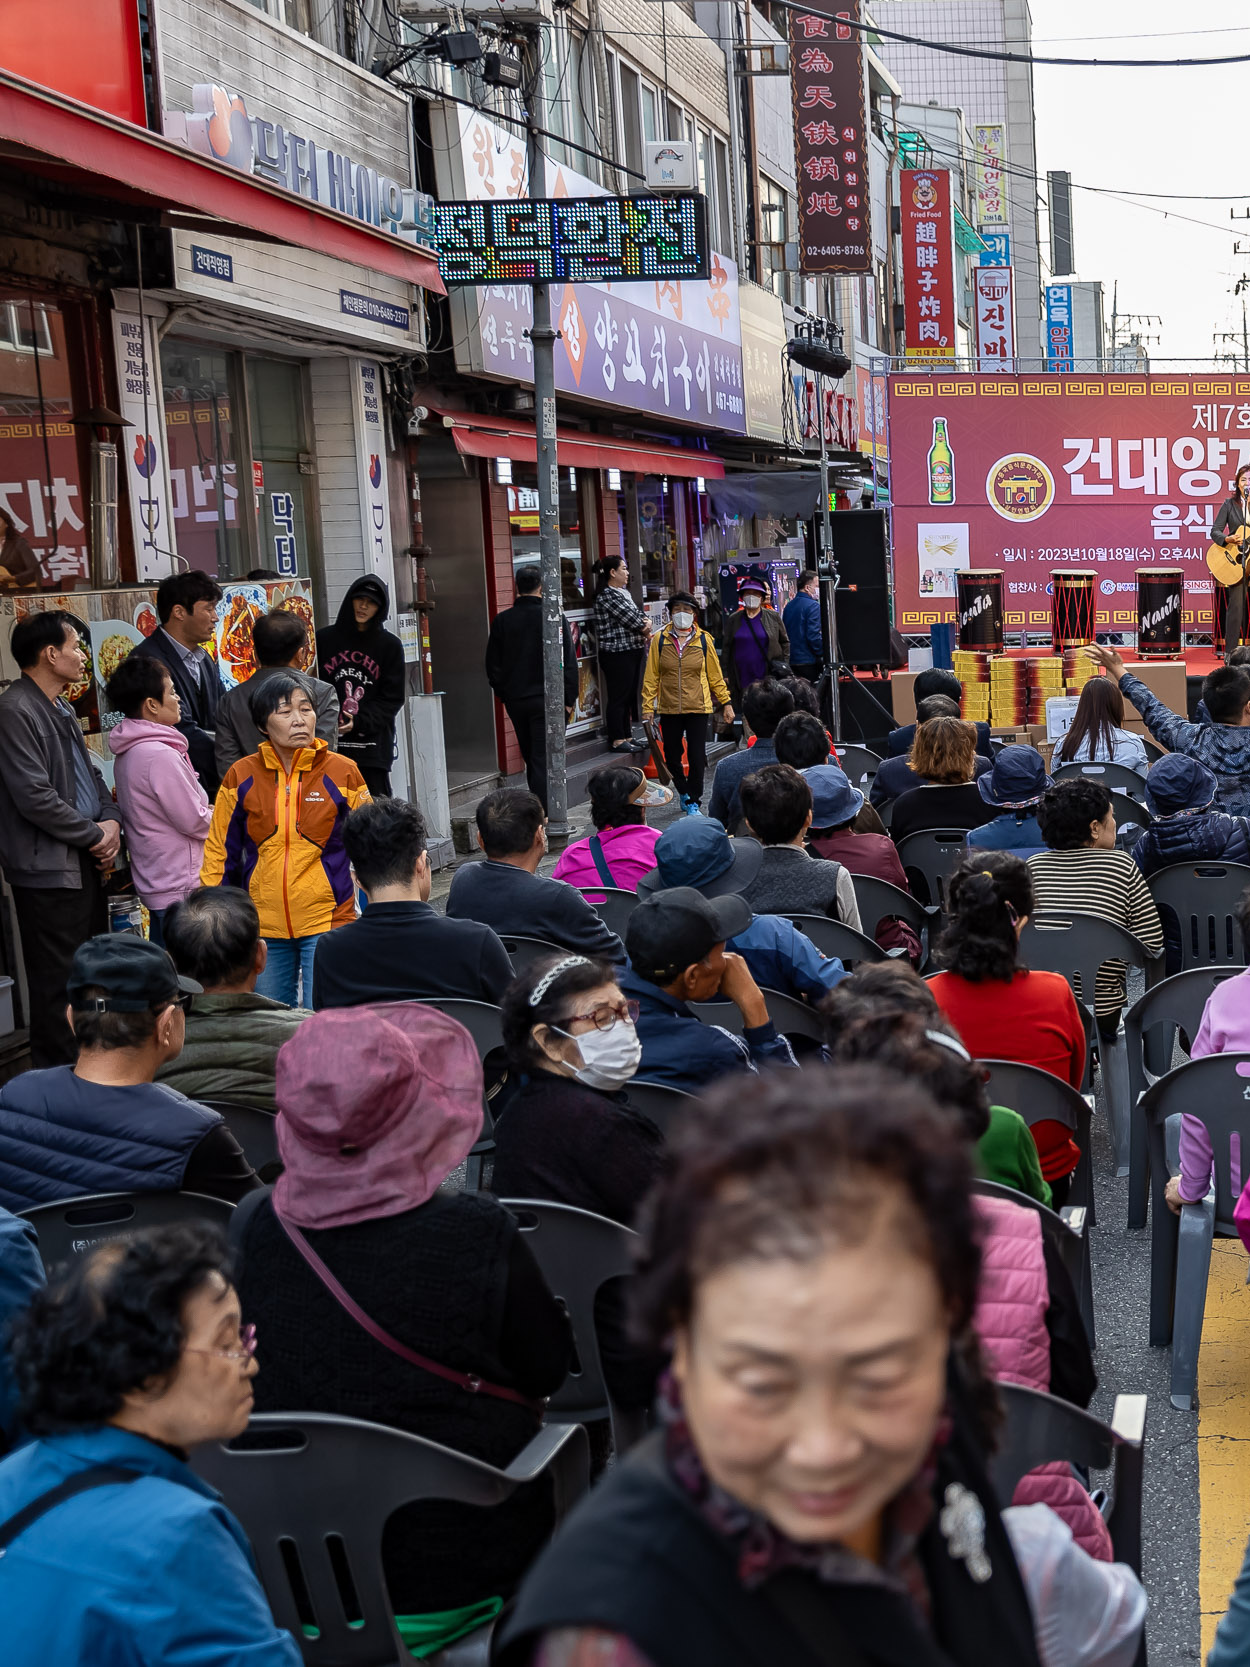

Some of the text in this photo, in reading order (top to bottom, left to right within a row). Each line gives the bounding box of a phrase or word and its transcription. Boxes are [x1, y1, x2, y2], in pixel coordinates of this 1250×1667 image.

[845, 128, 860, 230] 식위천식당
[196, 251, 230, 277] 건대직영점
[807, 245, 865, 257] 02-6405-8786
[915, 222, 942, 342] 趙胖子炸肉
[981, 287, 1007, 300] 진미
[594, 300, 713, 415] 양꼬치구이
[981, 304, 1009, 372] 진미
[272, 492, 298, 578] 닥터
[1002, 547, 1027, 562] 일시
[1038, 547, 1156, 563] 2023년10월18일(수)
[1160, 547, 1204, 562] 오후4시
[1008, 582, 1038, 593] 협찬사
